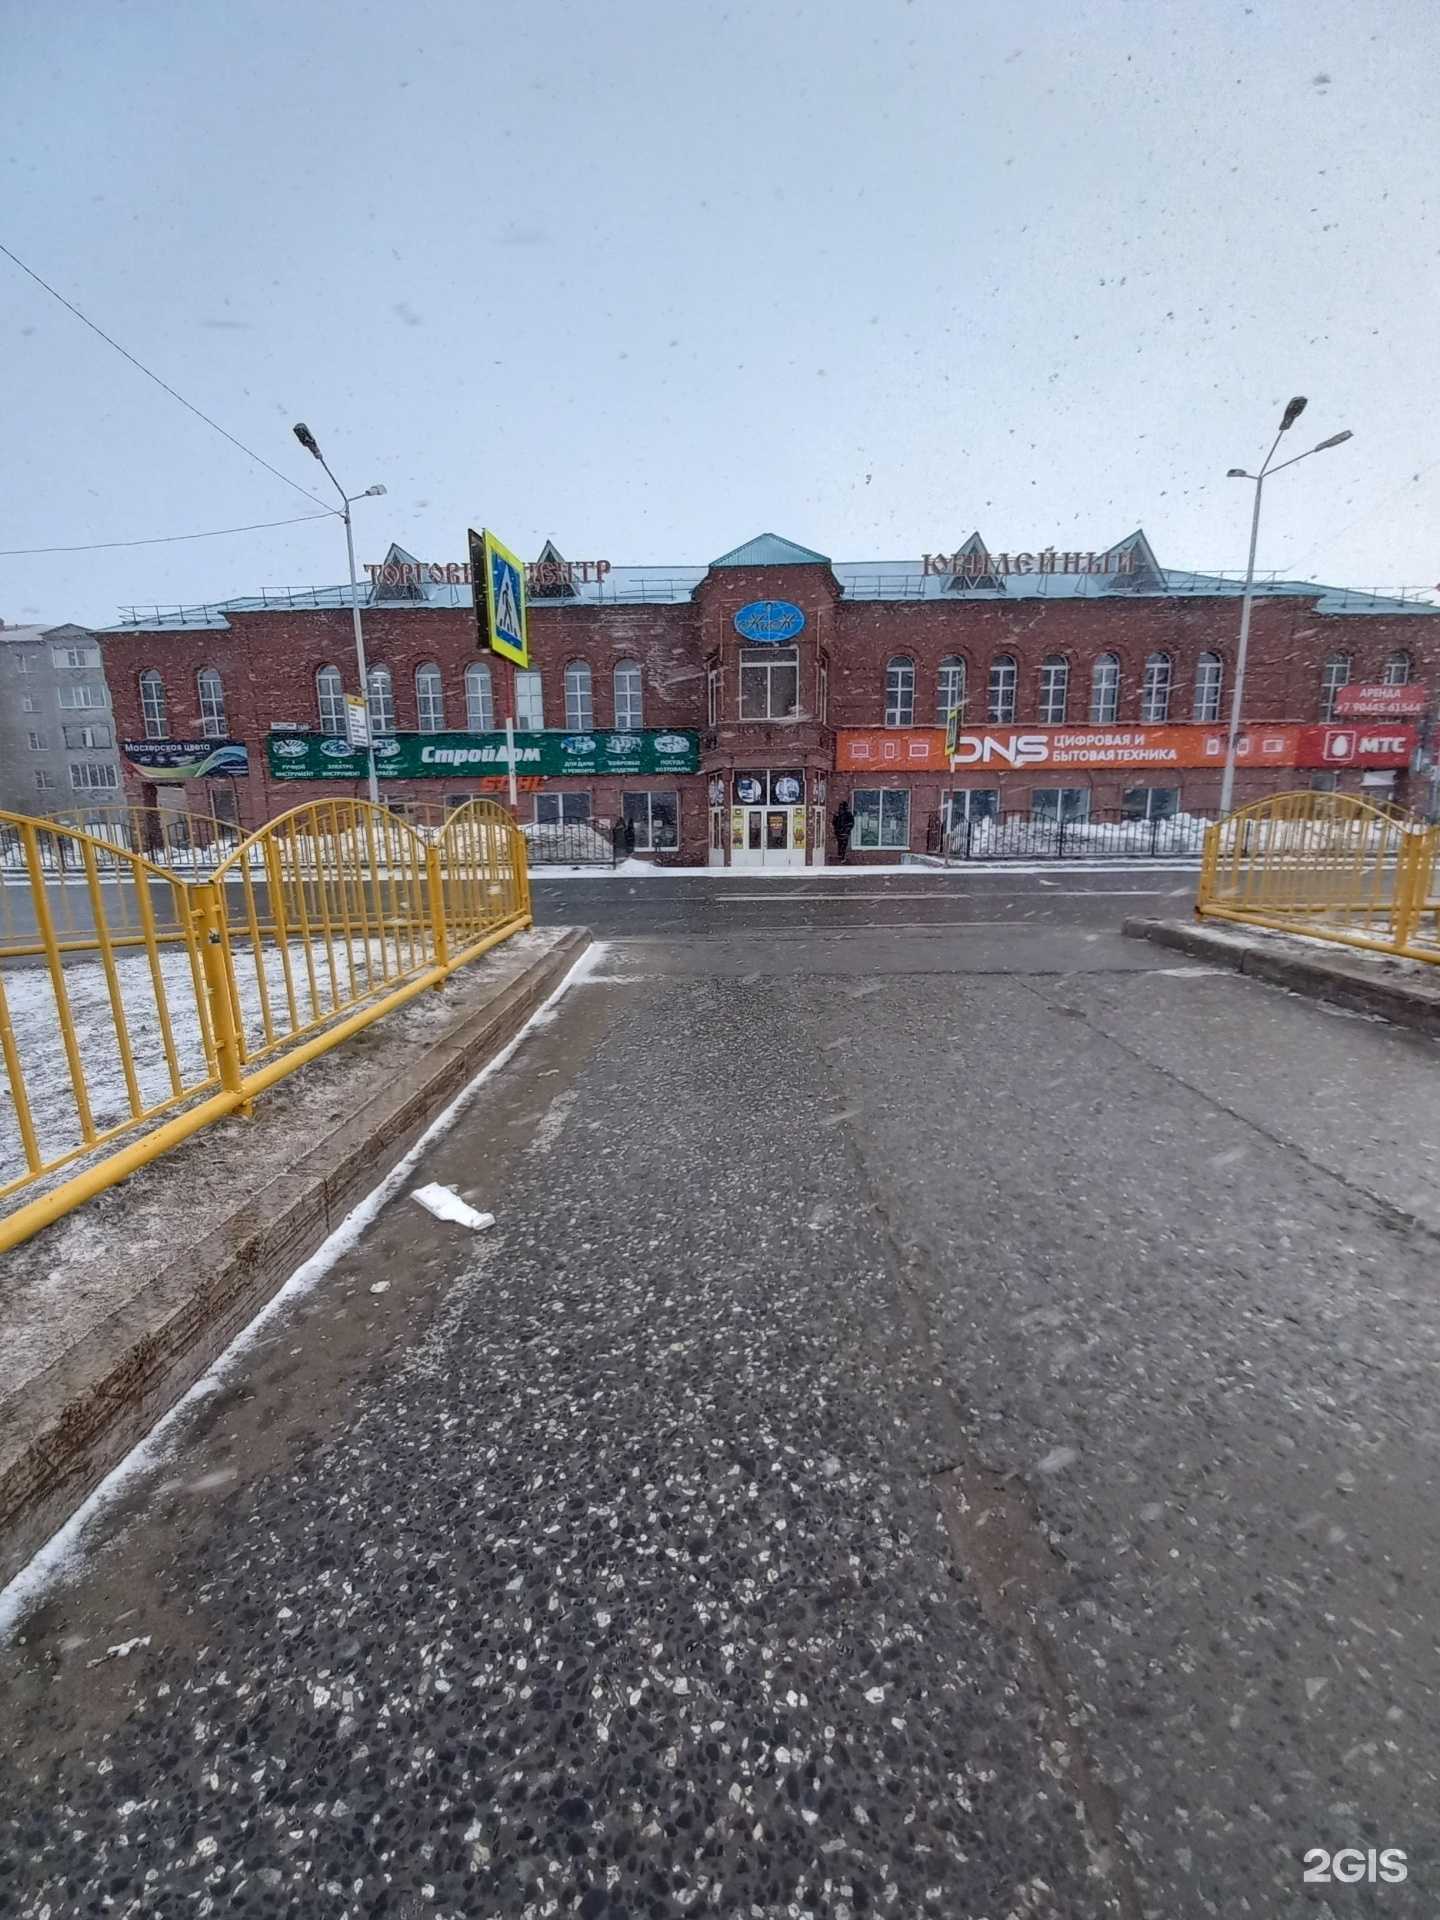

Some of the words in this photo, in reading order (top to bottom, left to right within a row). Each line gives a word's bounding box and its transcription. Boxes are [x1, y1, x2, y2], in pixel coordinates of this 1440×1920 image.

[363, 563, 472, 586] ТОРГОВ
[954, 735, 1049, 763] DNS
[1054, 734, 1131, 748] ЦИФРОВАЯ
[1135, 734, 1145, 746] И
[1358, 736, 1407, 753] МТС
[421, 744, 542, 767] СтройДом
[1053, 749, 1114, 762] БЫТОВАЯ
[1116, 748, 1178, 761] ТЕХНИКА
[481, 776, 546, 793] STHL
